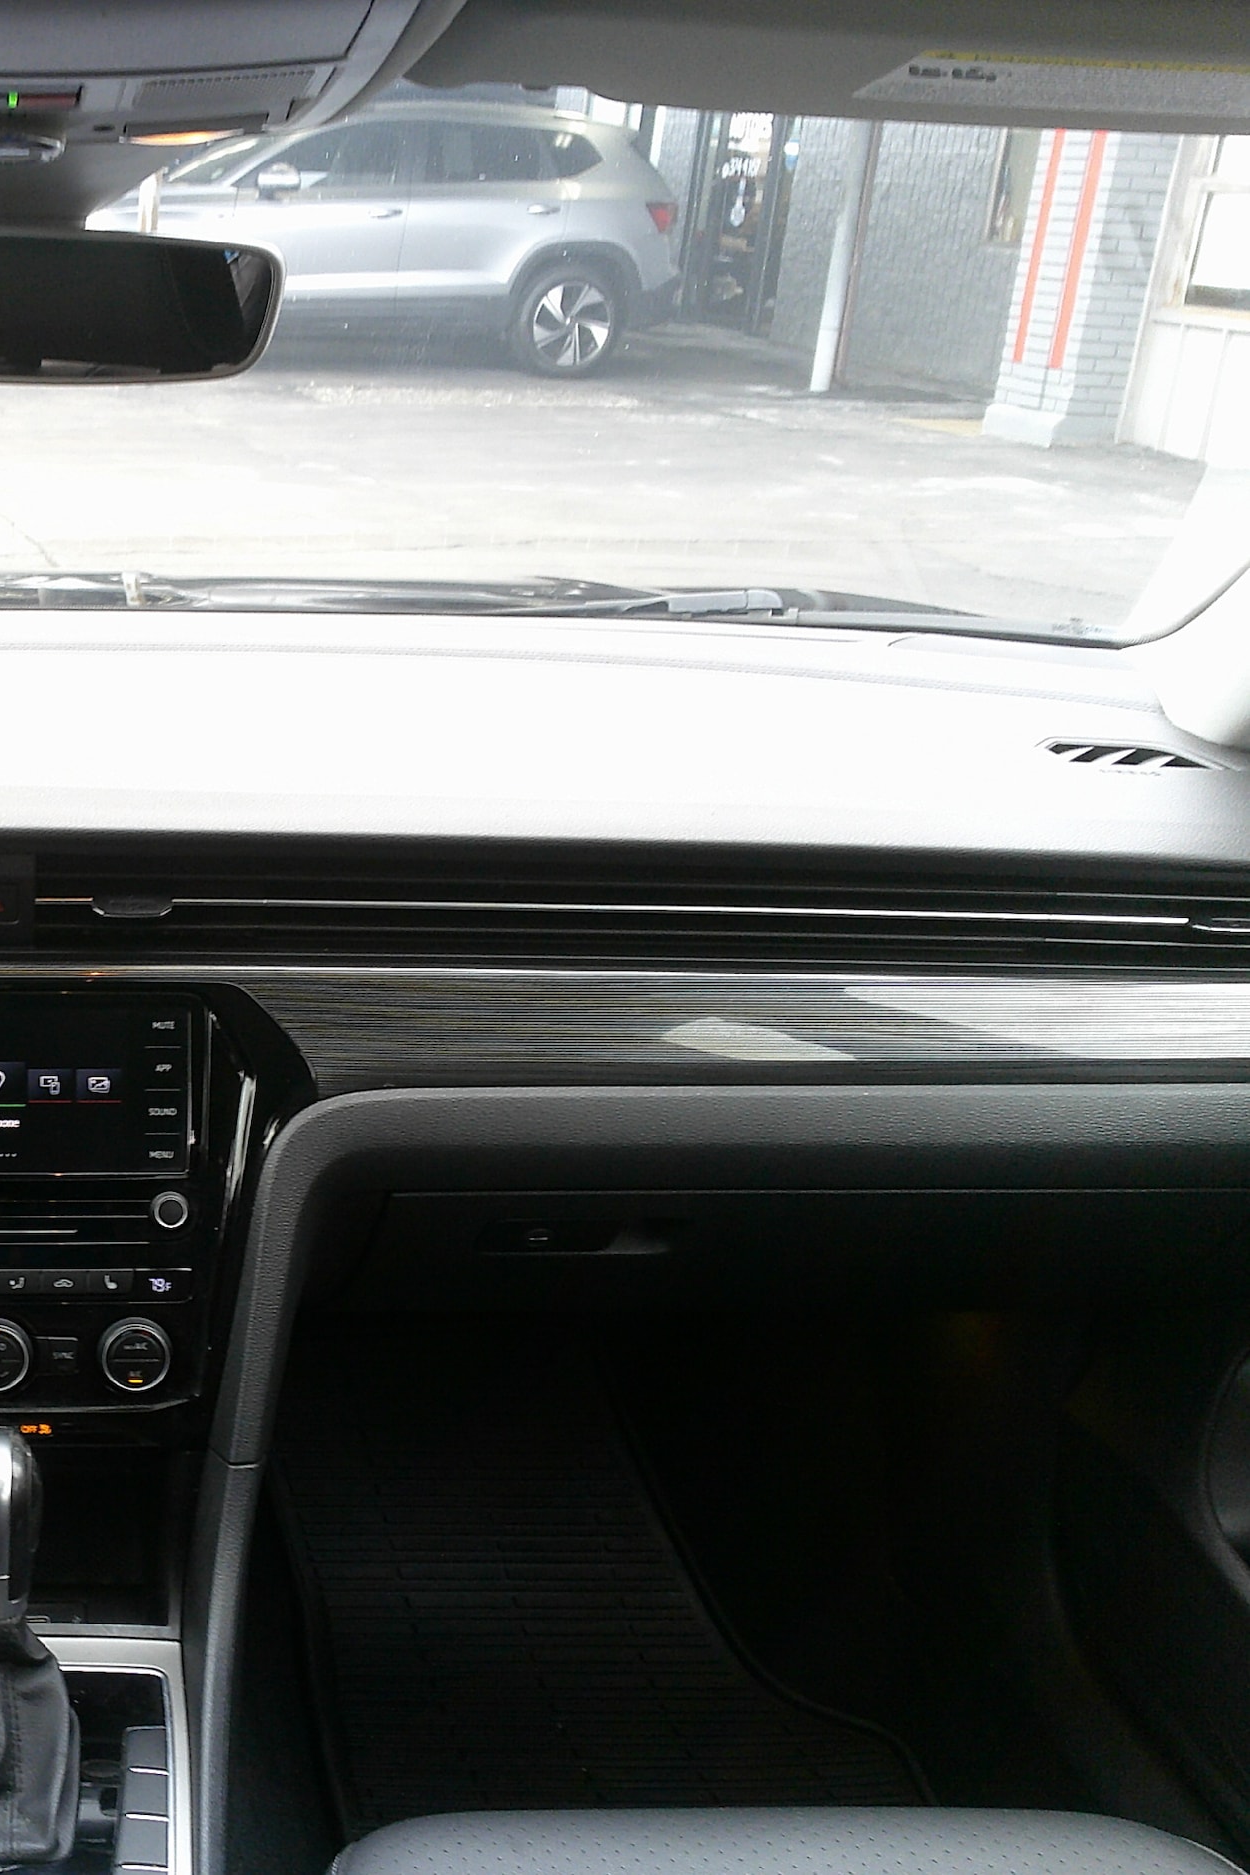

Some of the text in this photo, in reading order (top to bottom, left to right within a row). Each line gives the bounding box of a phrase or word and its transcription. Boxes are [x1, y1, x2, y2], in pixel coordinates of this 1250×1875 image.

[151, 1021, 176, 1030] MUTE
[154, 1063, 173, 1072] APP
[148, 1107, 178, 1116] SOUND
[148, 1150, 175, 1159] MENU
